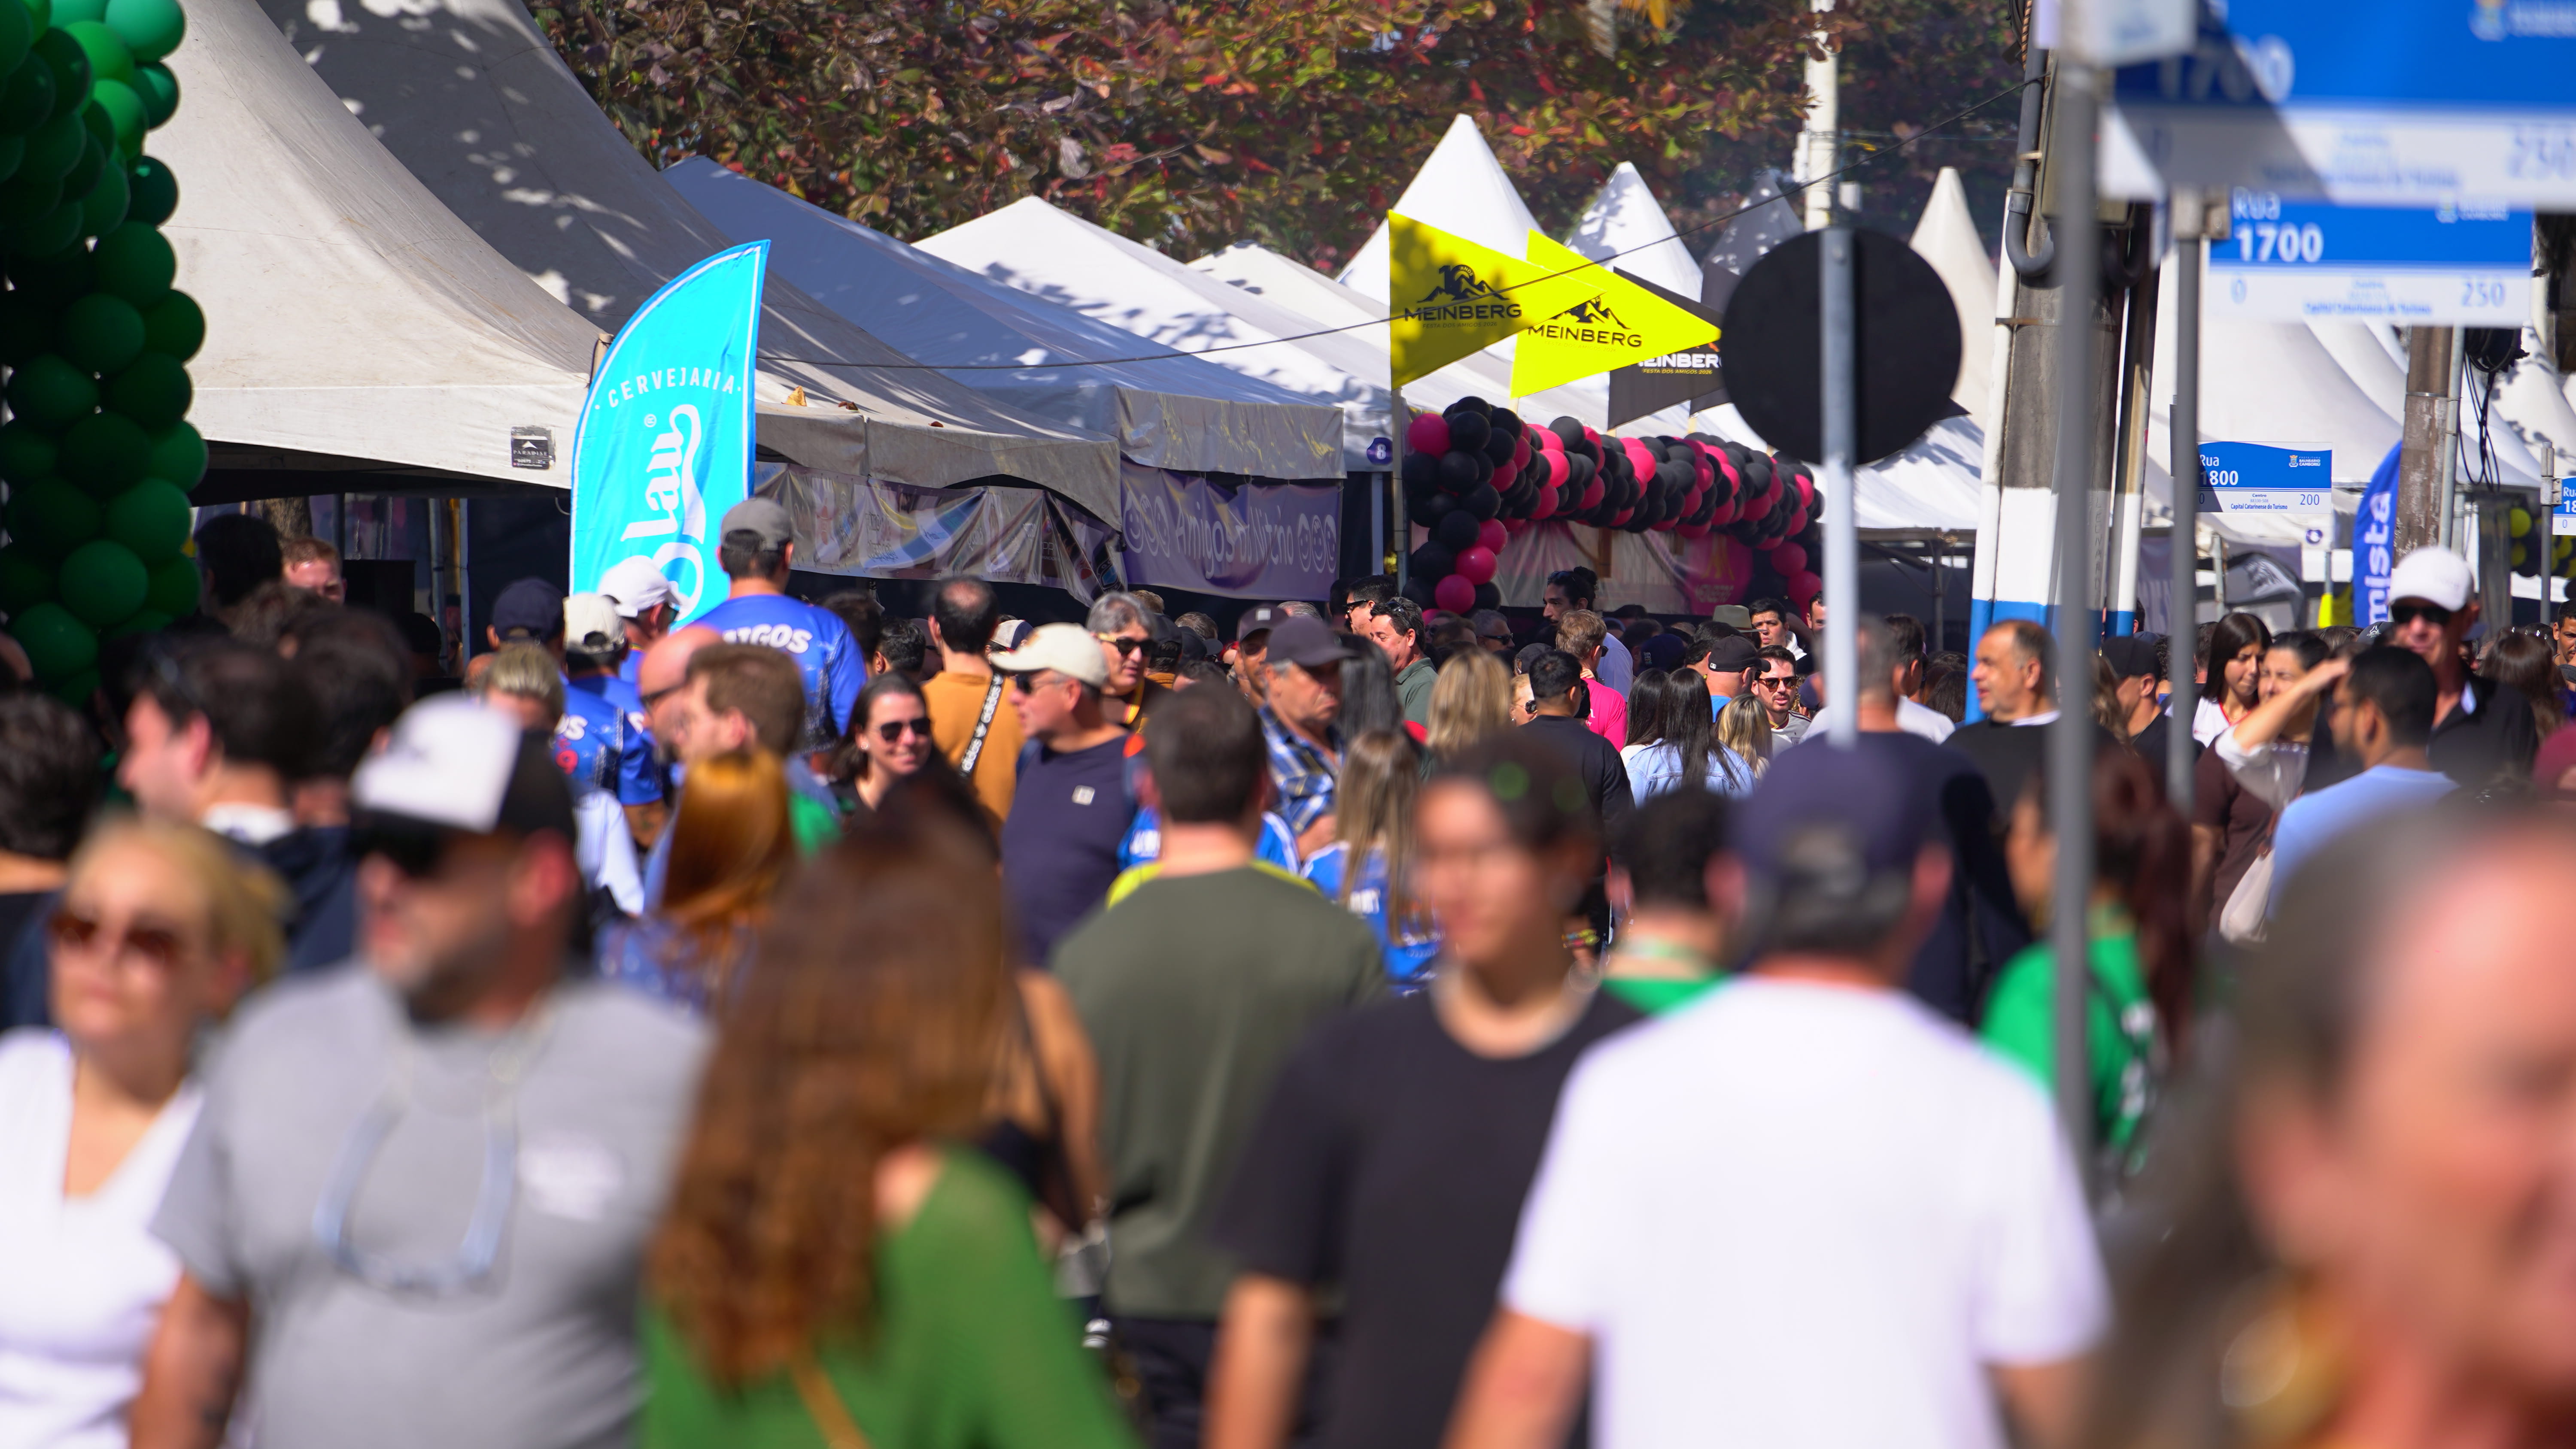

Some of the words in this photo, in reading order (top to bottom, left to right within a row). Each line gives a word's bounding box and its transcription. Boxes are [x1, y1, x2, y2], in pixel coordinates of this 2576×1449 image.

[2234, 222, 2324, 262] 1700
[2231, 275, 2246, 304] 0
[2461, 276, 2506, 307] 250
[1404, 303, 1522, 321] MEINBERG
[1528, 324, 1643, 348] MEINBERG
[1638, 352, 1722, 368] EINBER
[608, 367, 735, 408] CERVEJARIA
[1376, 444, 1387, 460] 8
[2199, 454, 2219, 466] Rua
[2200, 470, 2239, 485] 1800
[2199, 493, 2205, 504] 0
[2300, 494, 2320, 506] 200
[2563, 487, 2576, 497] Ru
[2562, 519, 2568, 528] 0
[1175, 497, 1235, 580] Amigos
[980, 685, 1001, 724] adidas
